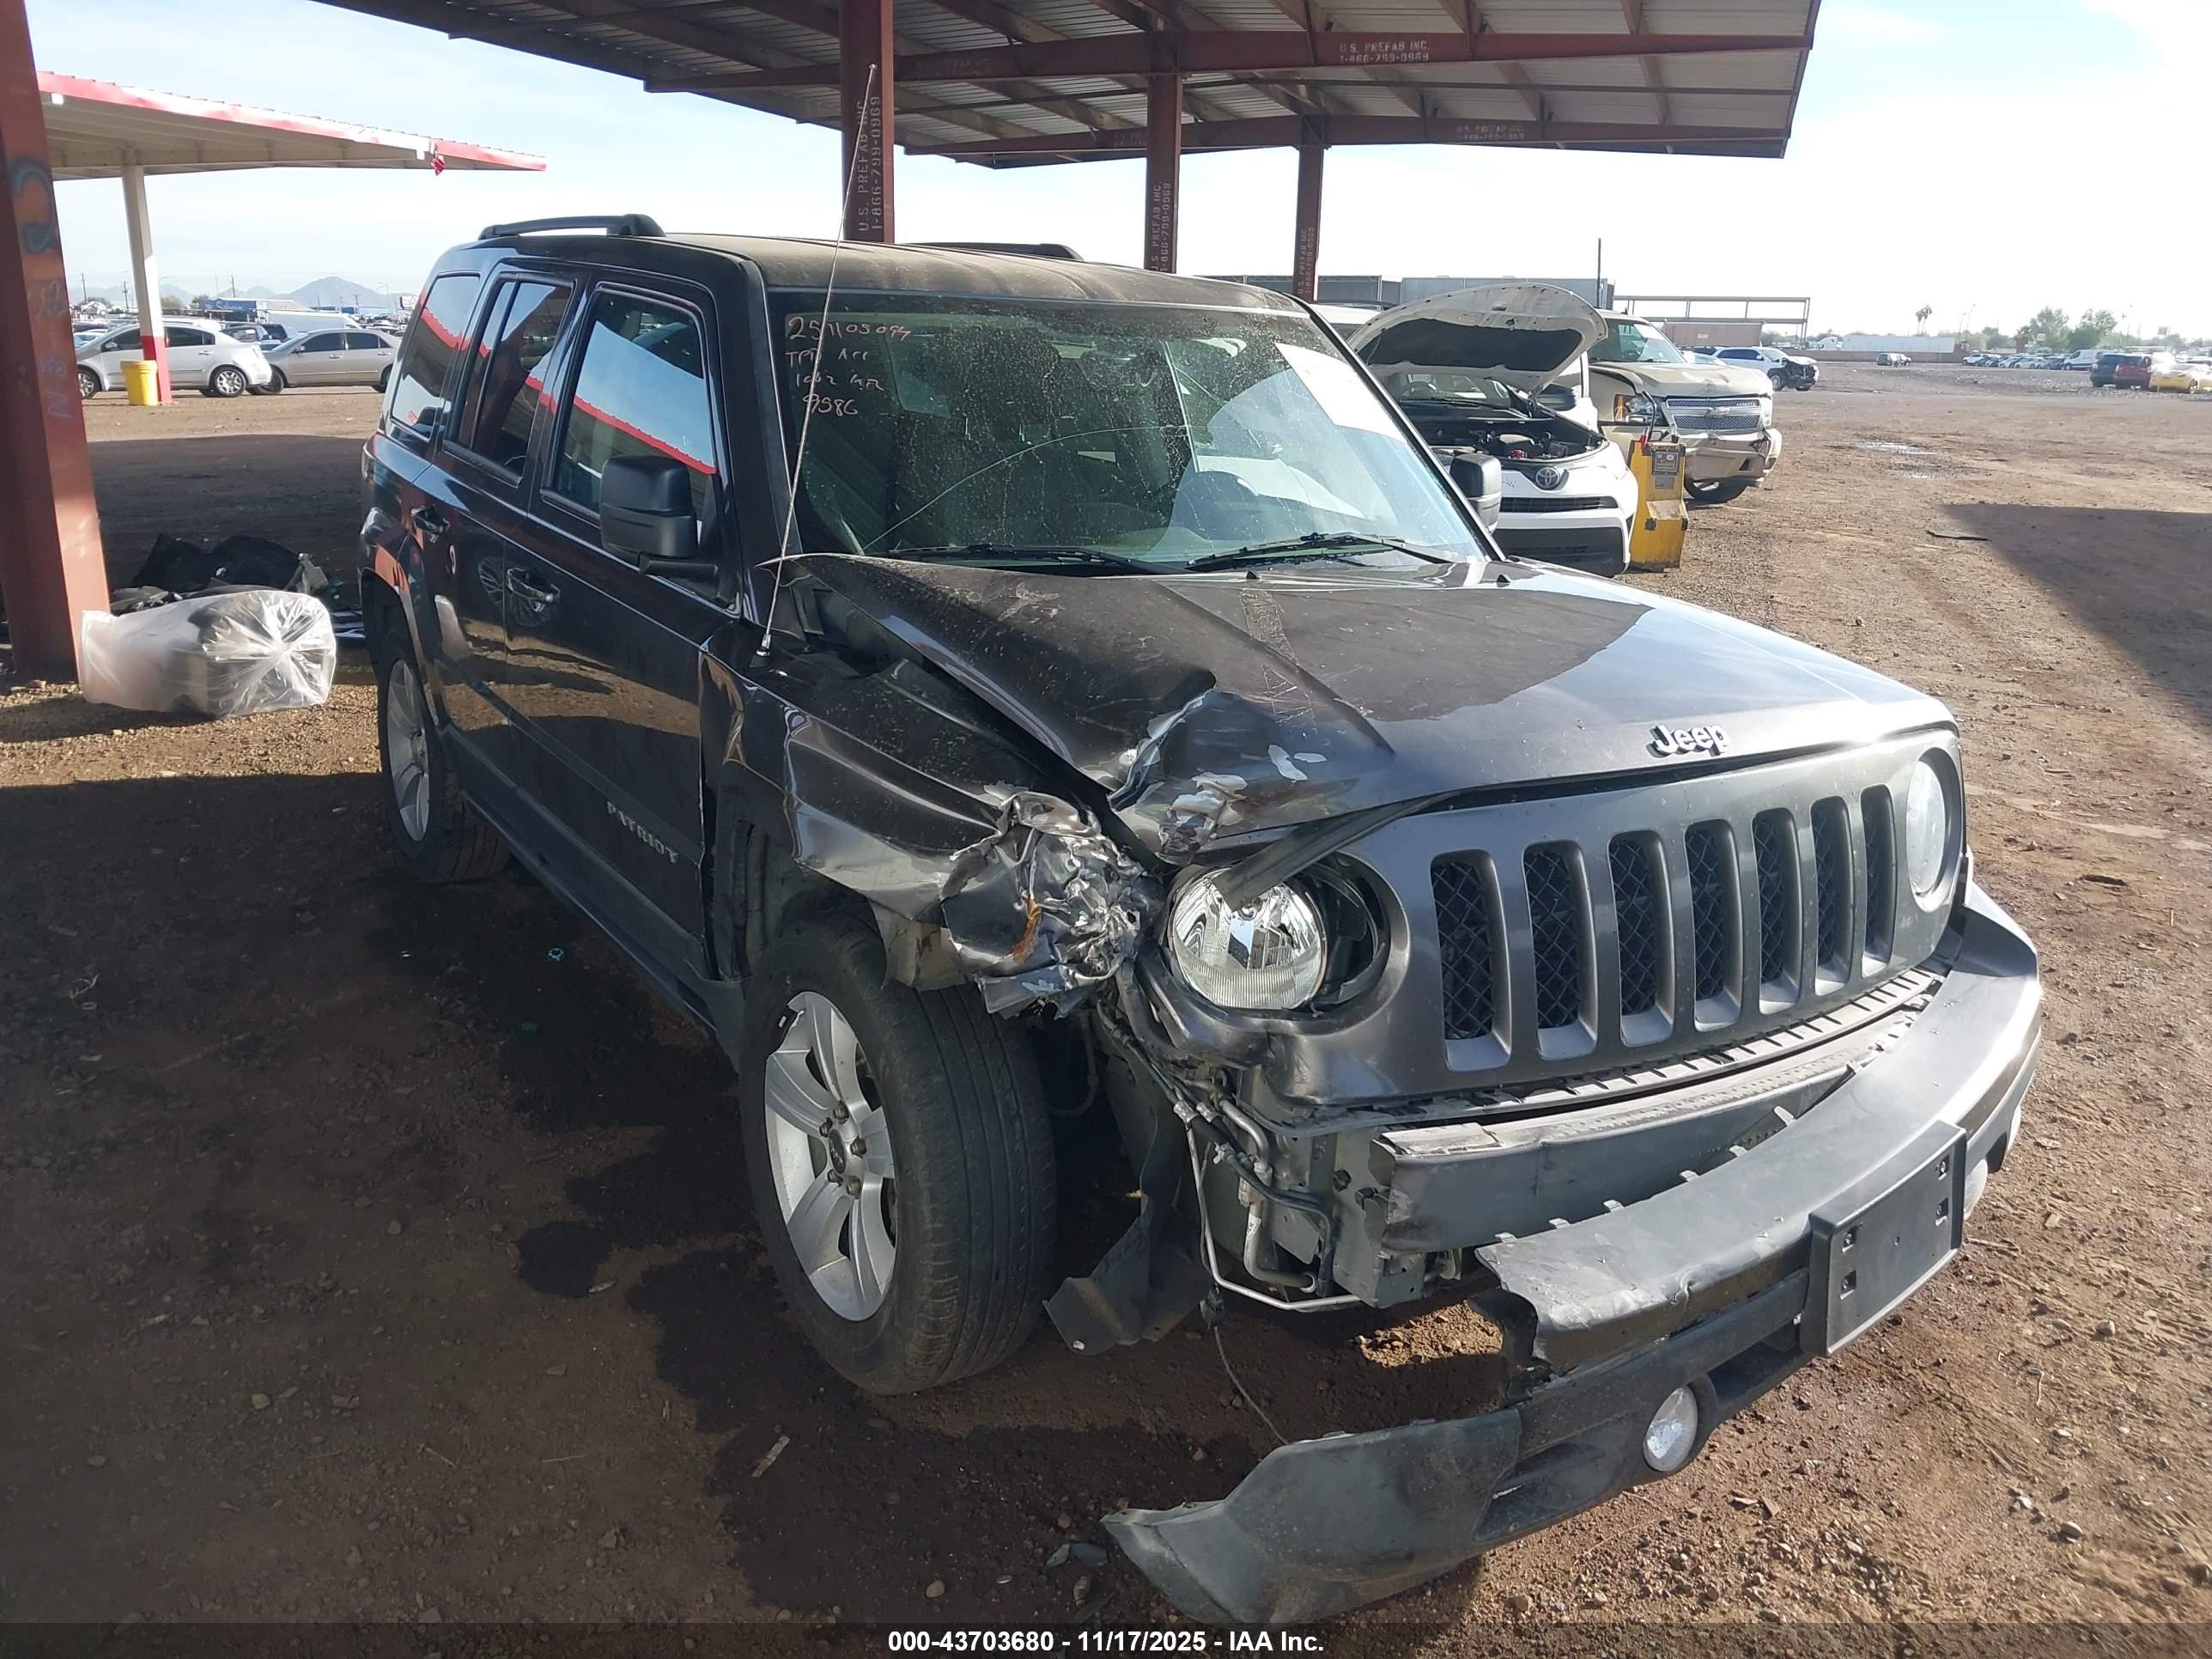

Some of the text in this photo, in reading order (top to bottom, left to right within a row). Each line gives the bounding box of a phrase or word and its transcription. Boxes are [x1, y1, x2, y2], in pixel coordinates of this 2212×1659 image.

[1365, 41, 1405, 52] PREFAB
[1410, 40, 1430, 52] INC.
[858, 134, 869, 193] PREFAB
[870, 96, 883, 230] 1-866-799-0969
[1152, 206, 1161, 247] PREFAB
[1644, 725, 1731, 758] Jeep
[606, 800, 678, 863] PATRIOT
